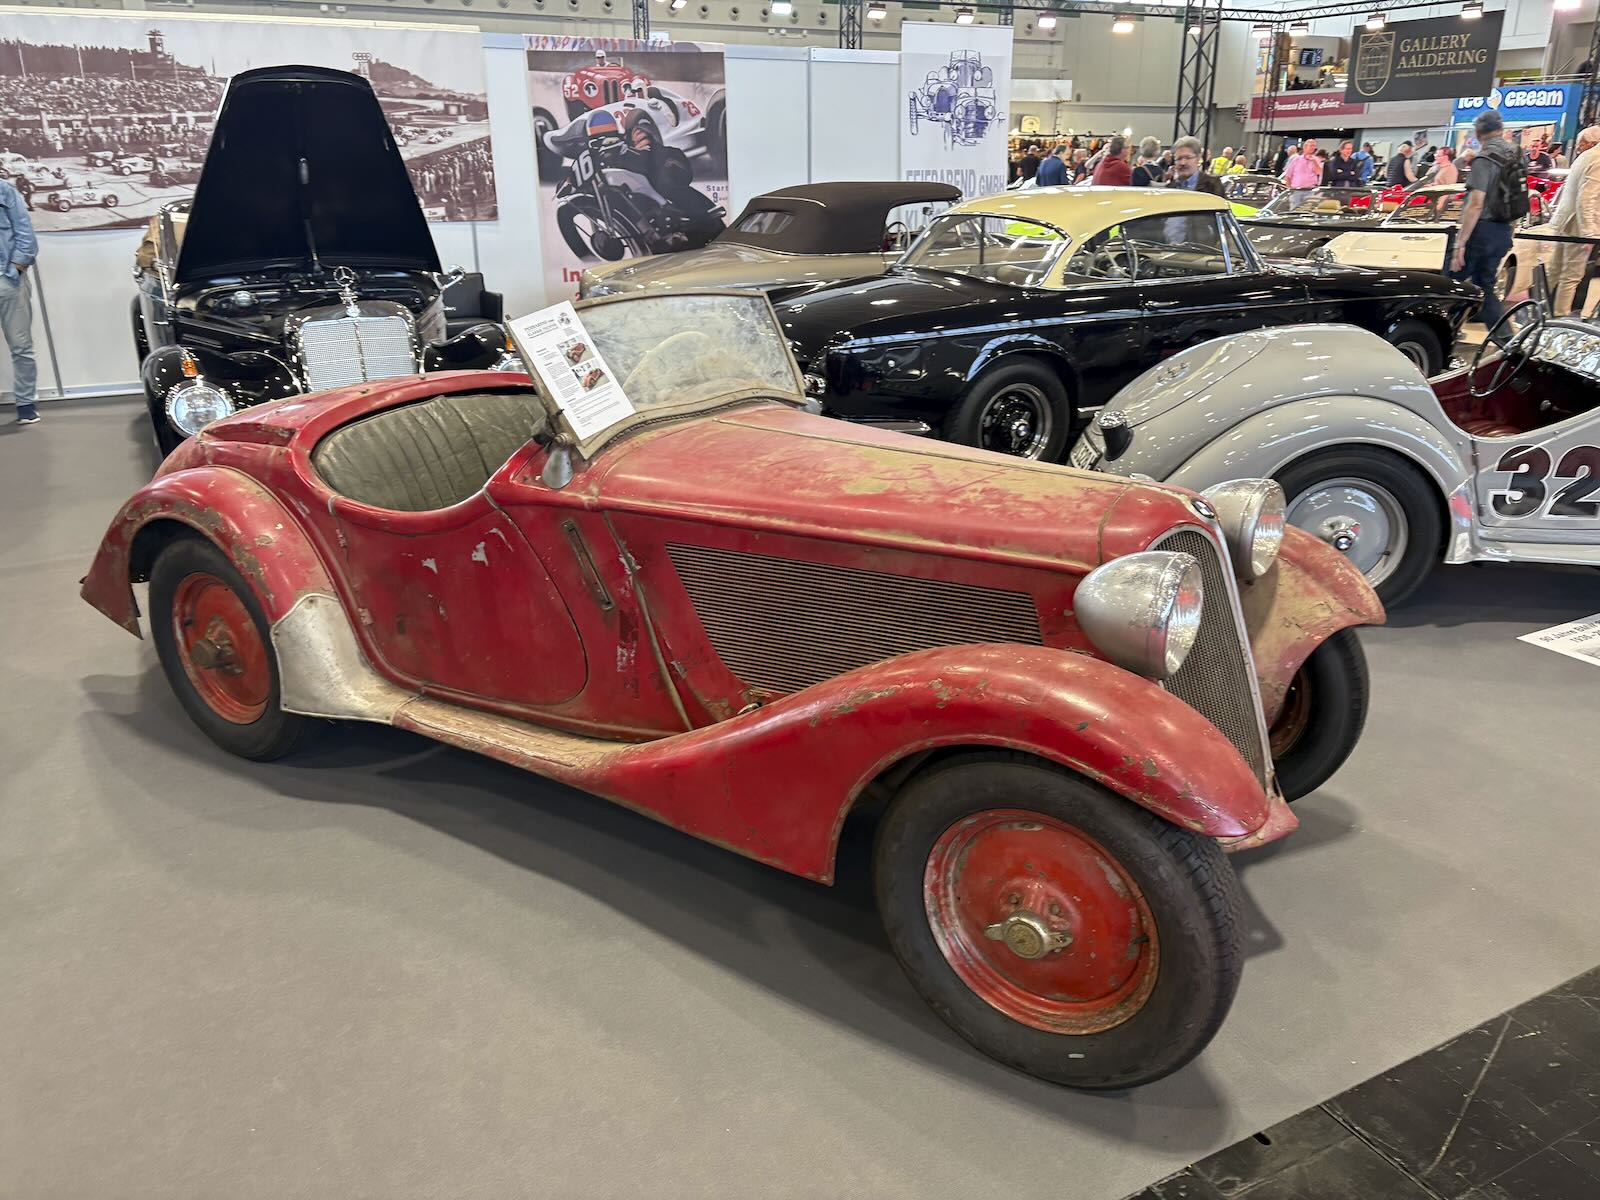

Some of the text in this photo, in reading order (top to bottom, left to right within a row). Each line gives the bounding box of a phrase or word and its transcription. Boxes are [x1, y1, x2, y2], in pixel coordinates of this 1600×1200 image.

[1400, 33, 1471, 53] GALLERY
[1396, 49, 1488, 69] AALDERING
[563, 84, 579, 98] 52
[1310, 99, 1319, 111] by
[572, 149, 594, 187] 16
[706, 184, 729, 192] Start
[1488, 444, 1600, 520] 32
